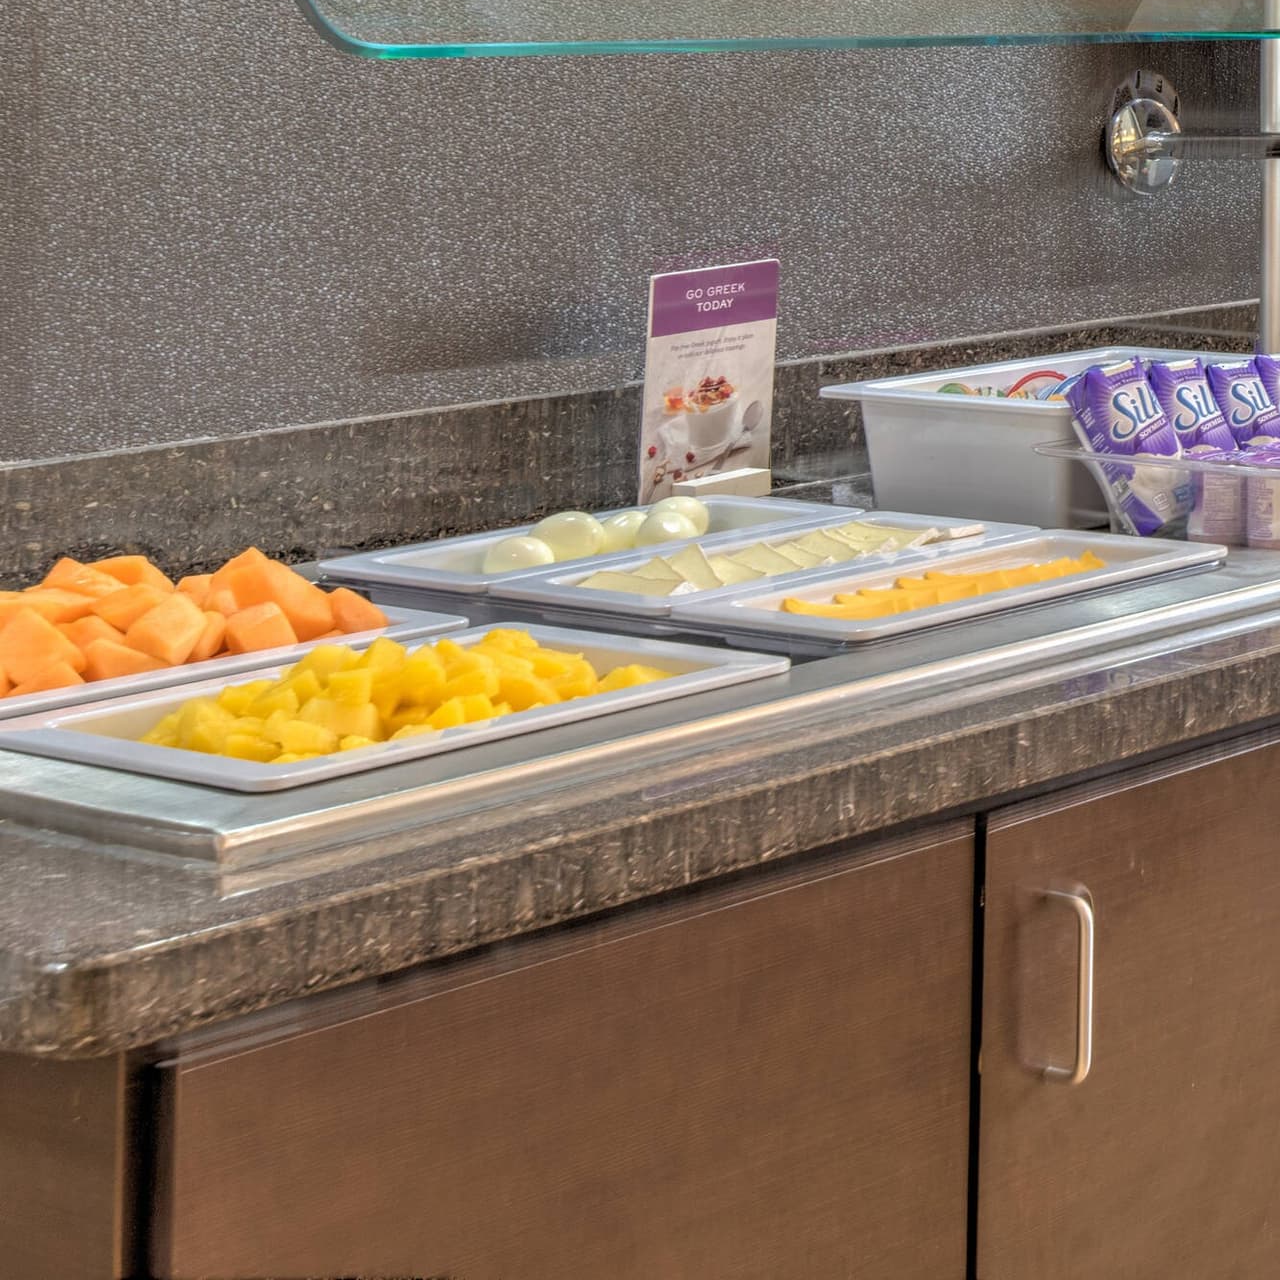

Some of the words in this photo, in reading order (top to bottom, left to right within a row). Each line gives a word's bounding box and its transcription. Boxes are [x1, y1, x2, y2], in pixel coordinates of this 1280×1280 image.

[685, 288, 704, 300] GO
[706, 282, 746, 297] GREEK
[696, 298, 735, 313] TODAY
